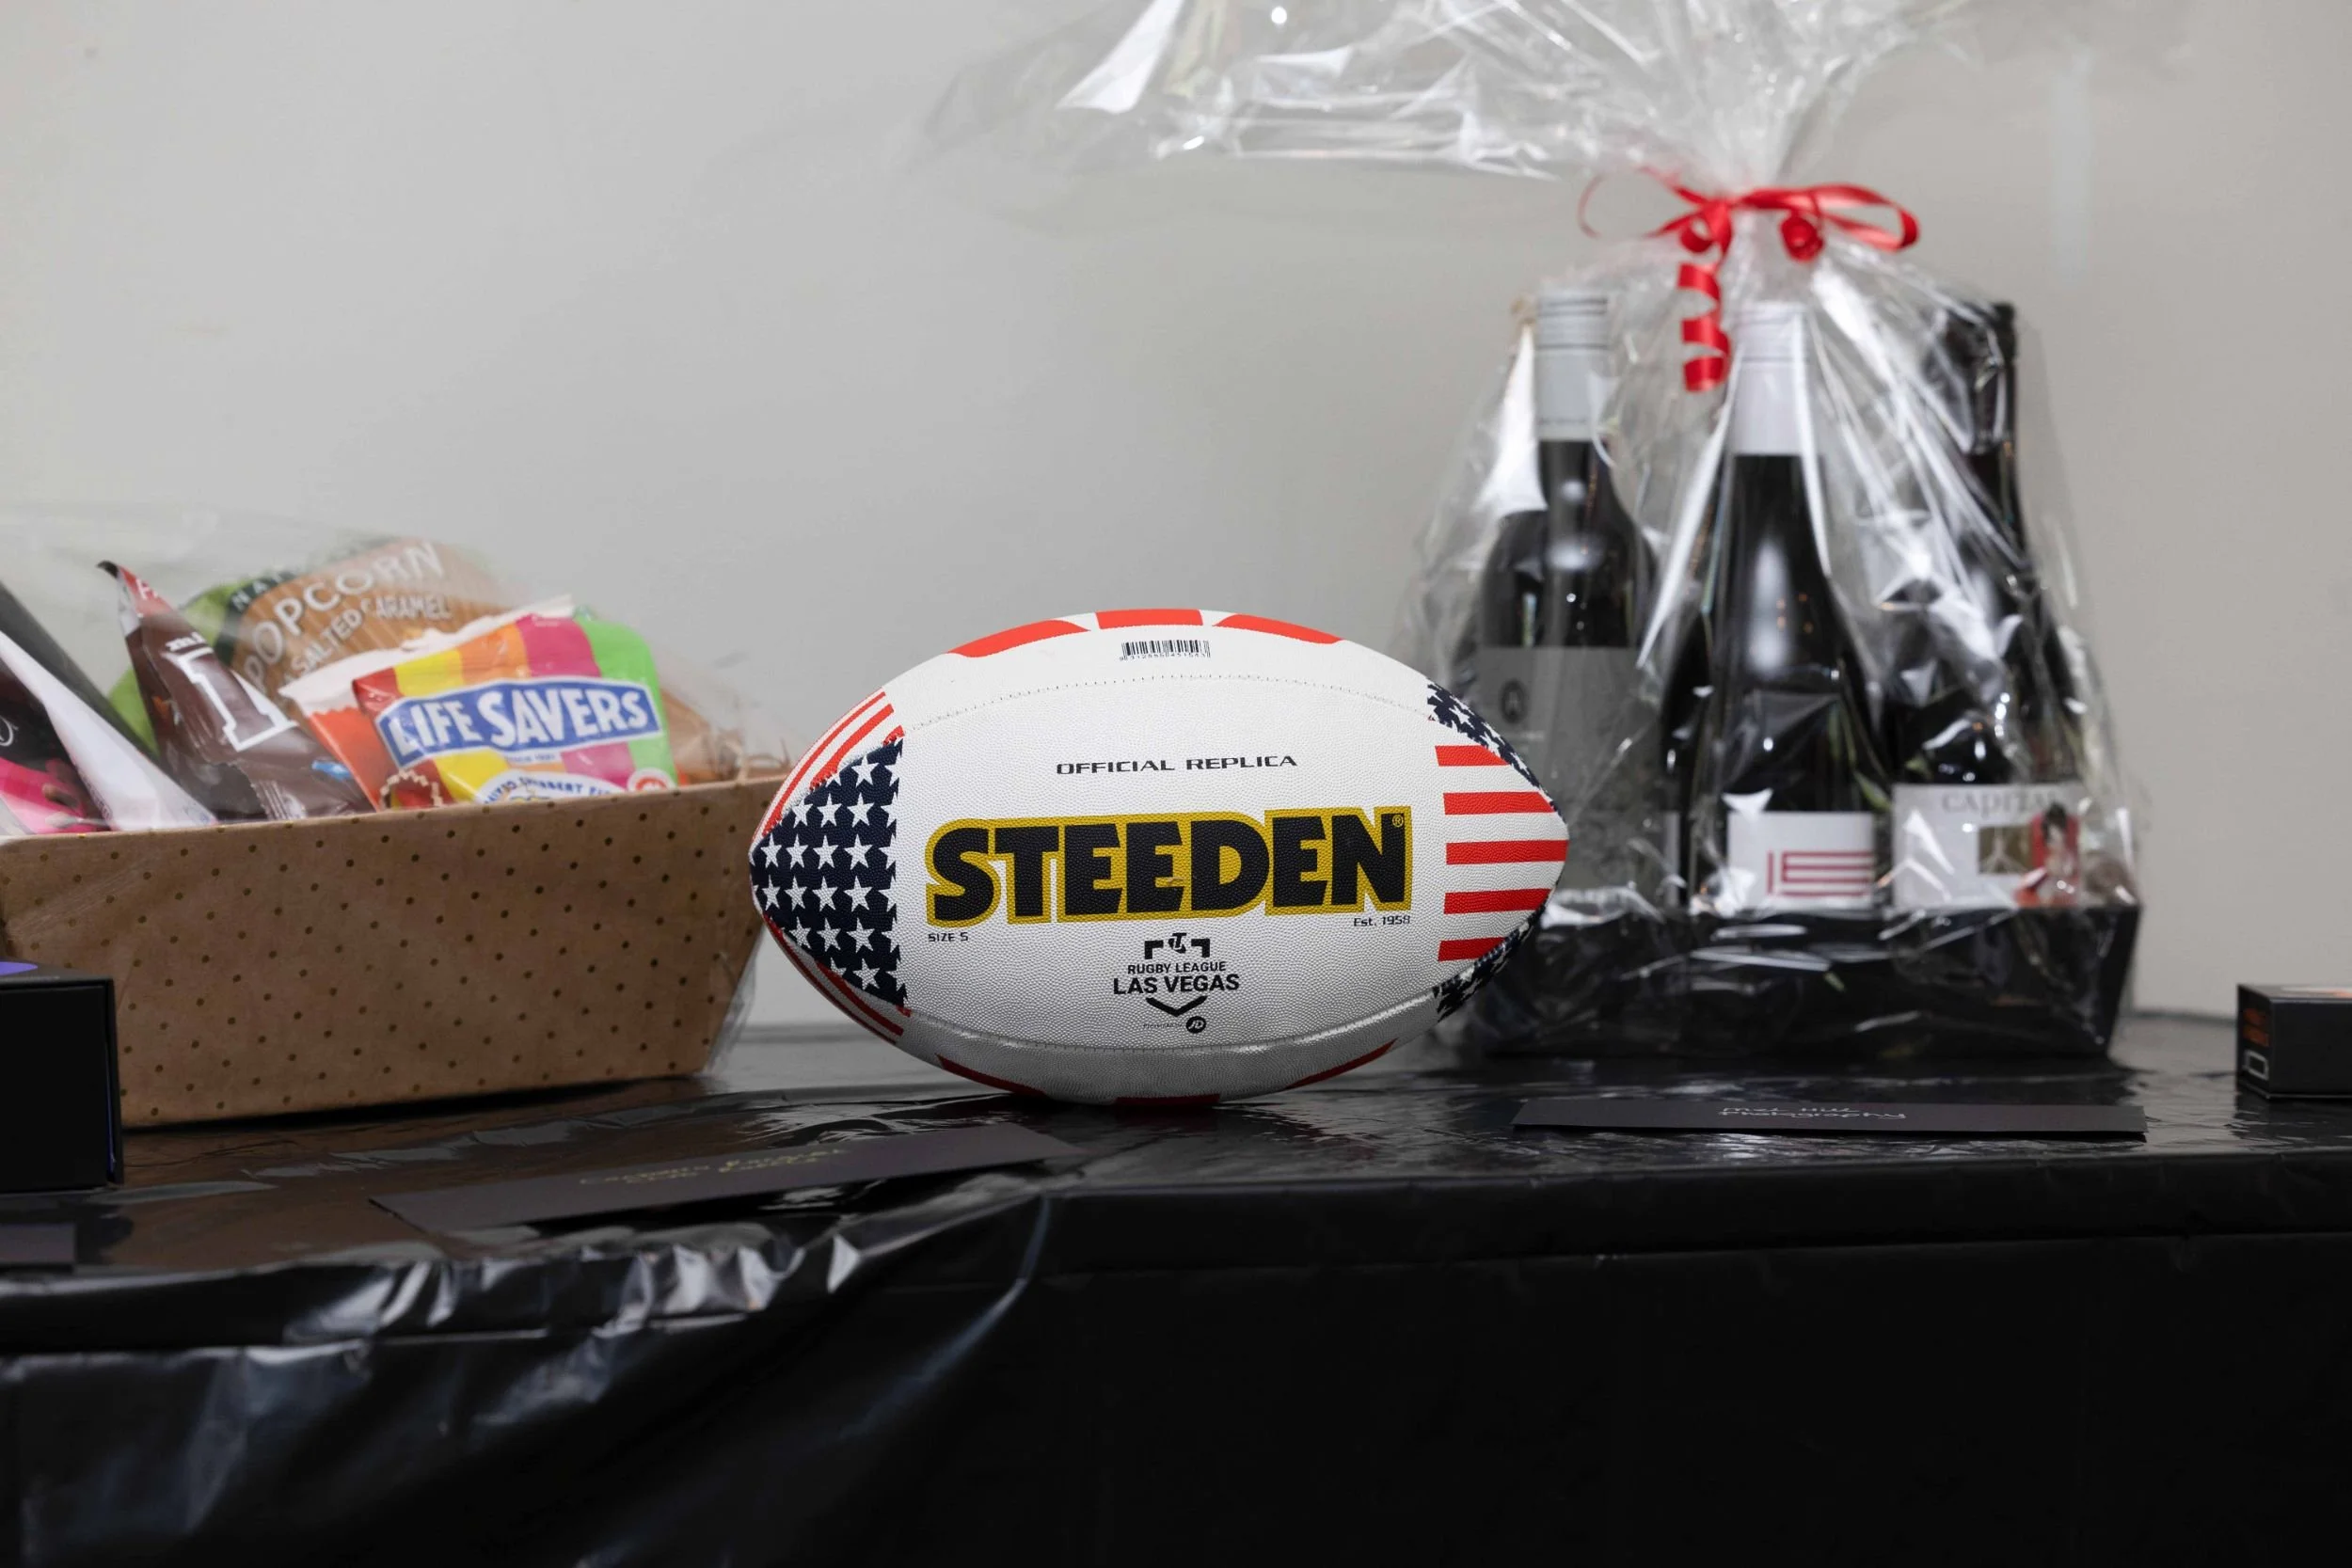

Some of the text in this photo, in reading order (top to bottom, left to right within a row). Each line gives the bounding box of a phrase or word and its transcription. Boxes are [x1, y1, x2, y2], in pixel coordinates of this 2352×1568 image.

[243, 542, 445, 693] POPCORN
[288, 594, 453, 676] SALTED CARAMEL
[388, 689, 649, 757] LIFE SAVERS
[1057, 755, 1297, 775] OFFICIAL REPLICA
[929, 807, 1411, 925] STEEDEN
[1354, 914, 1411, 927] Est. 1958
[928, 931, 969, 942] SIZE 5
[1127, 960, 1227, 974] RUGBY LEAGUE
[1113, 974, 1240, 995] LAS VEGAS
